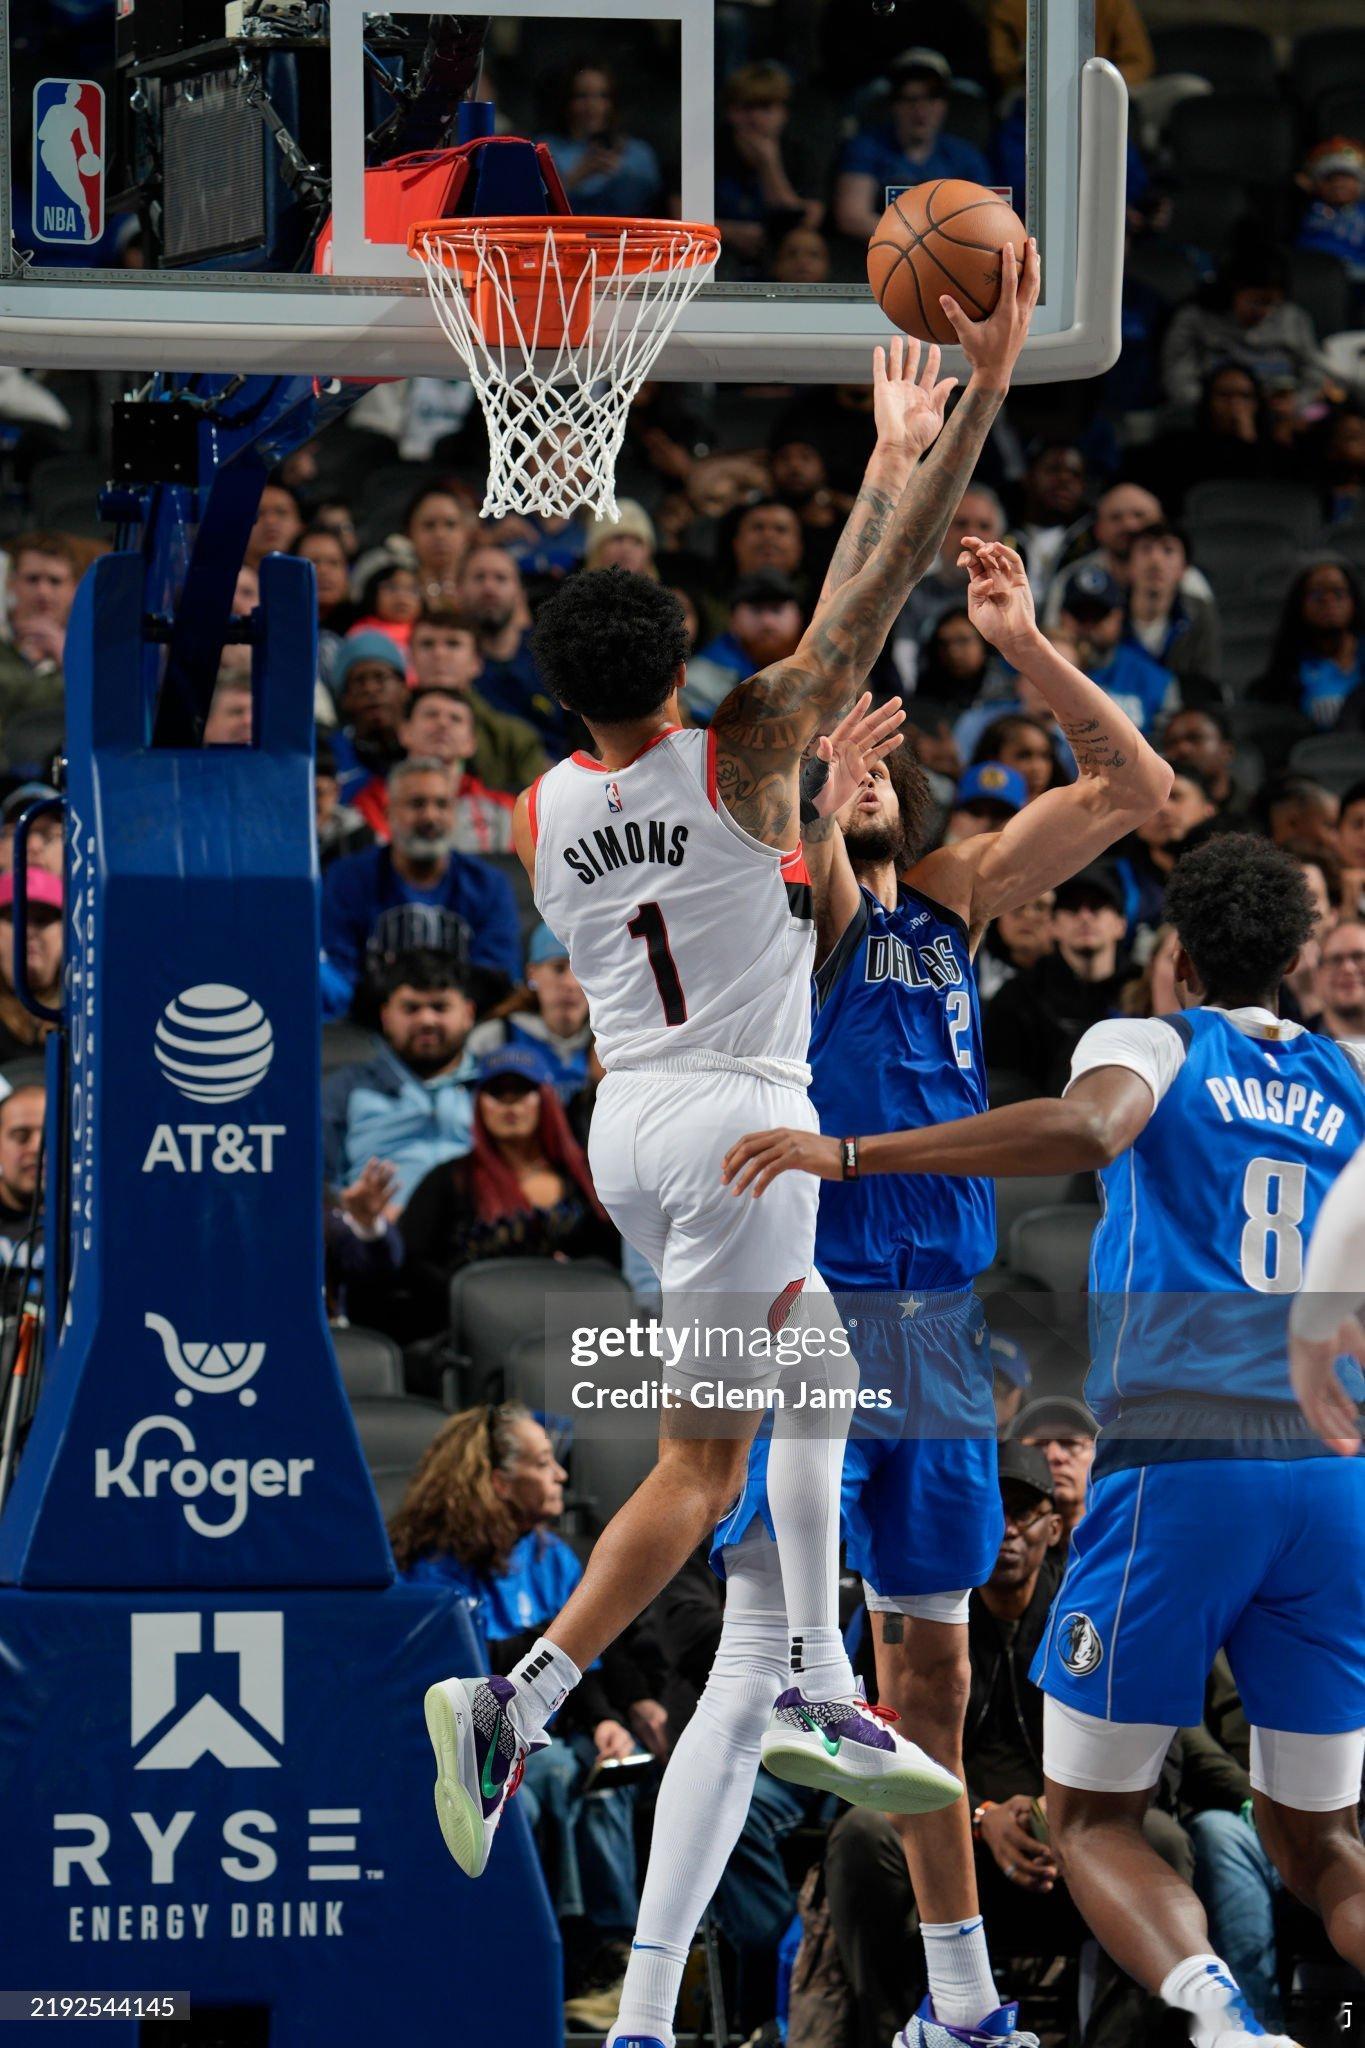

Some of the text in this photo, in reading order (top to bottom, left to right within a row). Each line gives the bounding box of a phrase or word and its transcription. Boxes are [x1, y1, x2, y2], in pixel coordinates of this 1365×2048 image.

[43, 206, 77, 232] NBA
[563, 820, 689, 884] SIMONS
[86, 836, 95, 1016] RESORTS
[626, 901, 688, 1027] 1
[865, 932, 962, 991] DALAS
[946, 991, 971, 1068] 2
[141, 1123, 287, 1174] AT&T
[1205, 1076, 1345, 1146] PROSPER
[84, 1069, 94, 1250] CASINOS
[1240, 1157, 1306, 1294] 8
[95, 1414, 315, 1539] Kroger
[53, 1808, 361, 1887] RYSE
[69, 1901, 344, 1942] ENERGY DRINK
